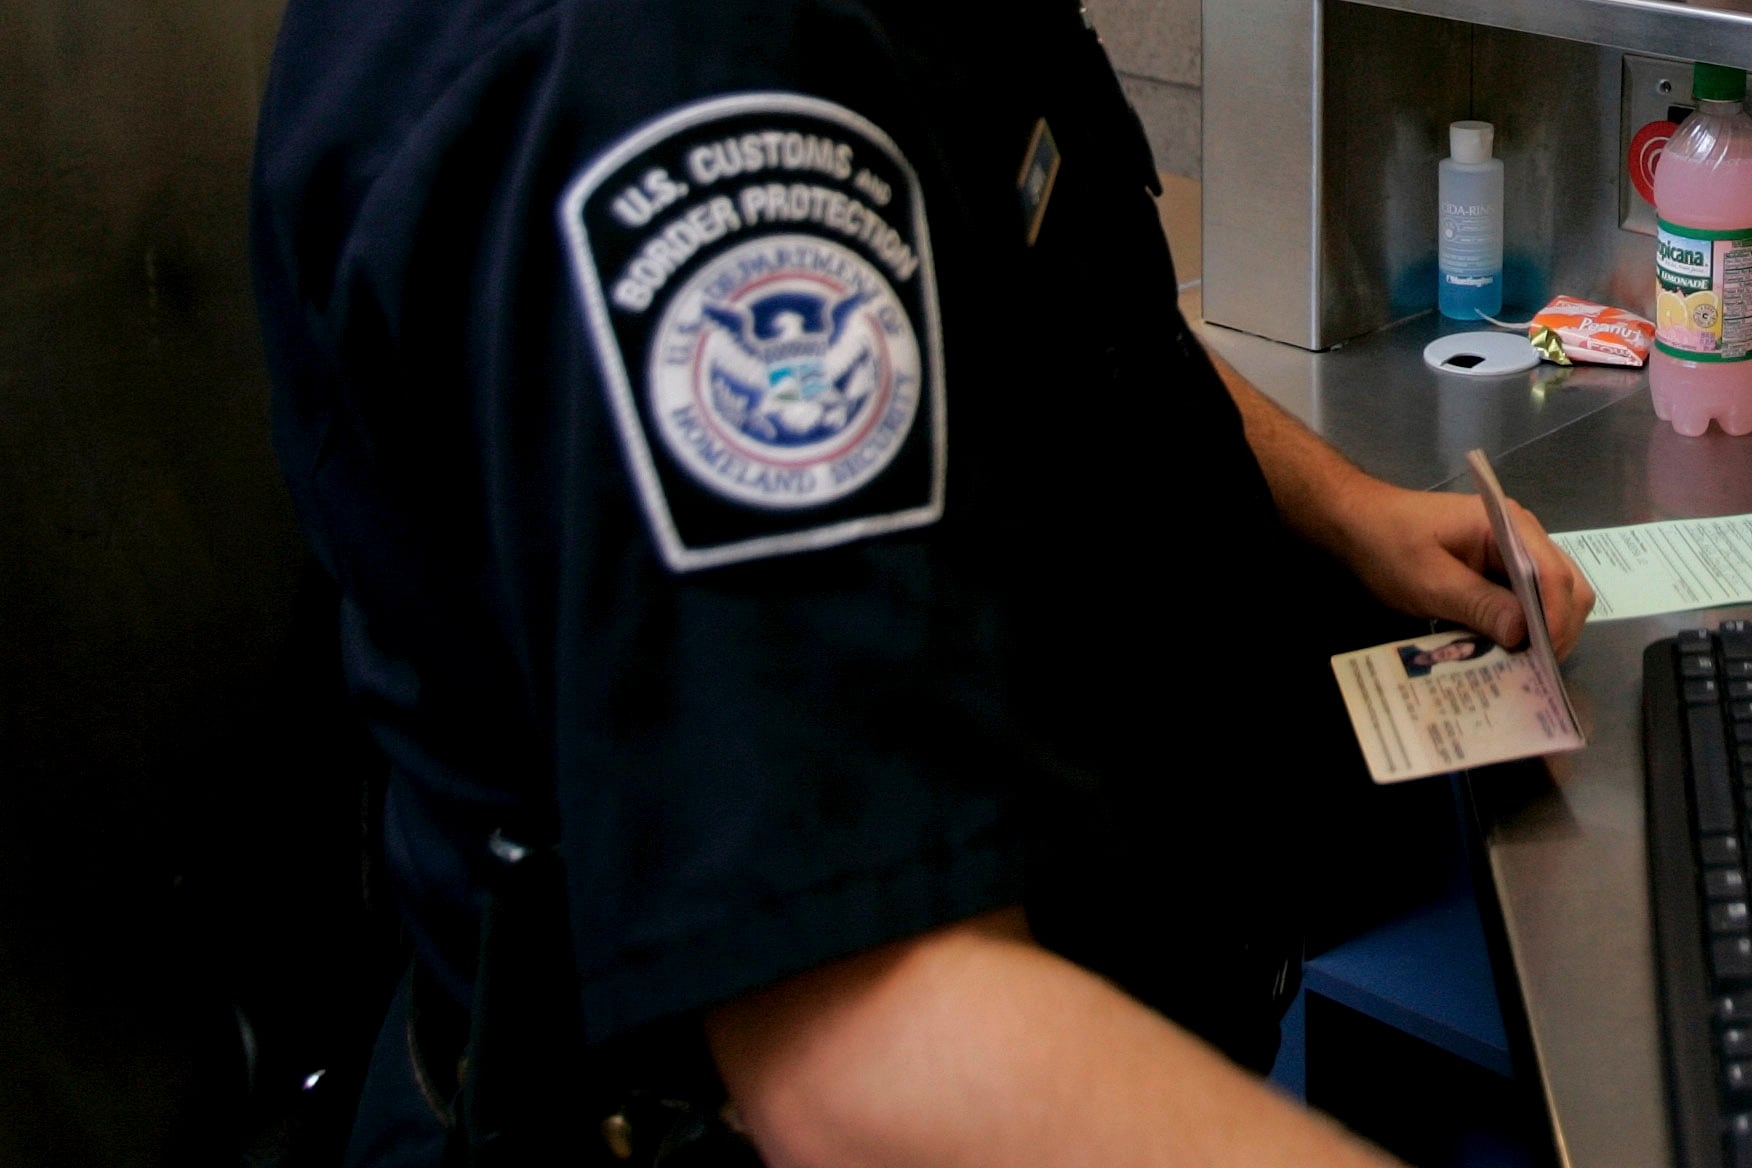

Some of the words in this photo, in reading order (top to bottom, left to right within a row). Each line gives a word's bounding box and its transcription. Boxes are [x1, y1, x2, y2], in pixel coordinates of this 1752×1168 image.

[611, 167, 690, 228] U.S.
[688, 132, 854, 184] CUSTOMS
[612, 194, 742, 313] BORDER
[740, 182, 918, 282] PROTECTION
[673, 406, 818, 493] HOMELAND
